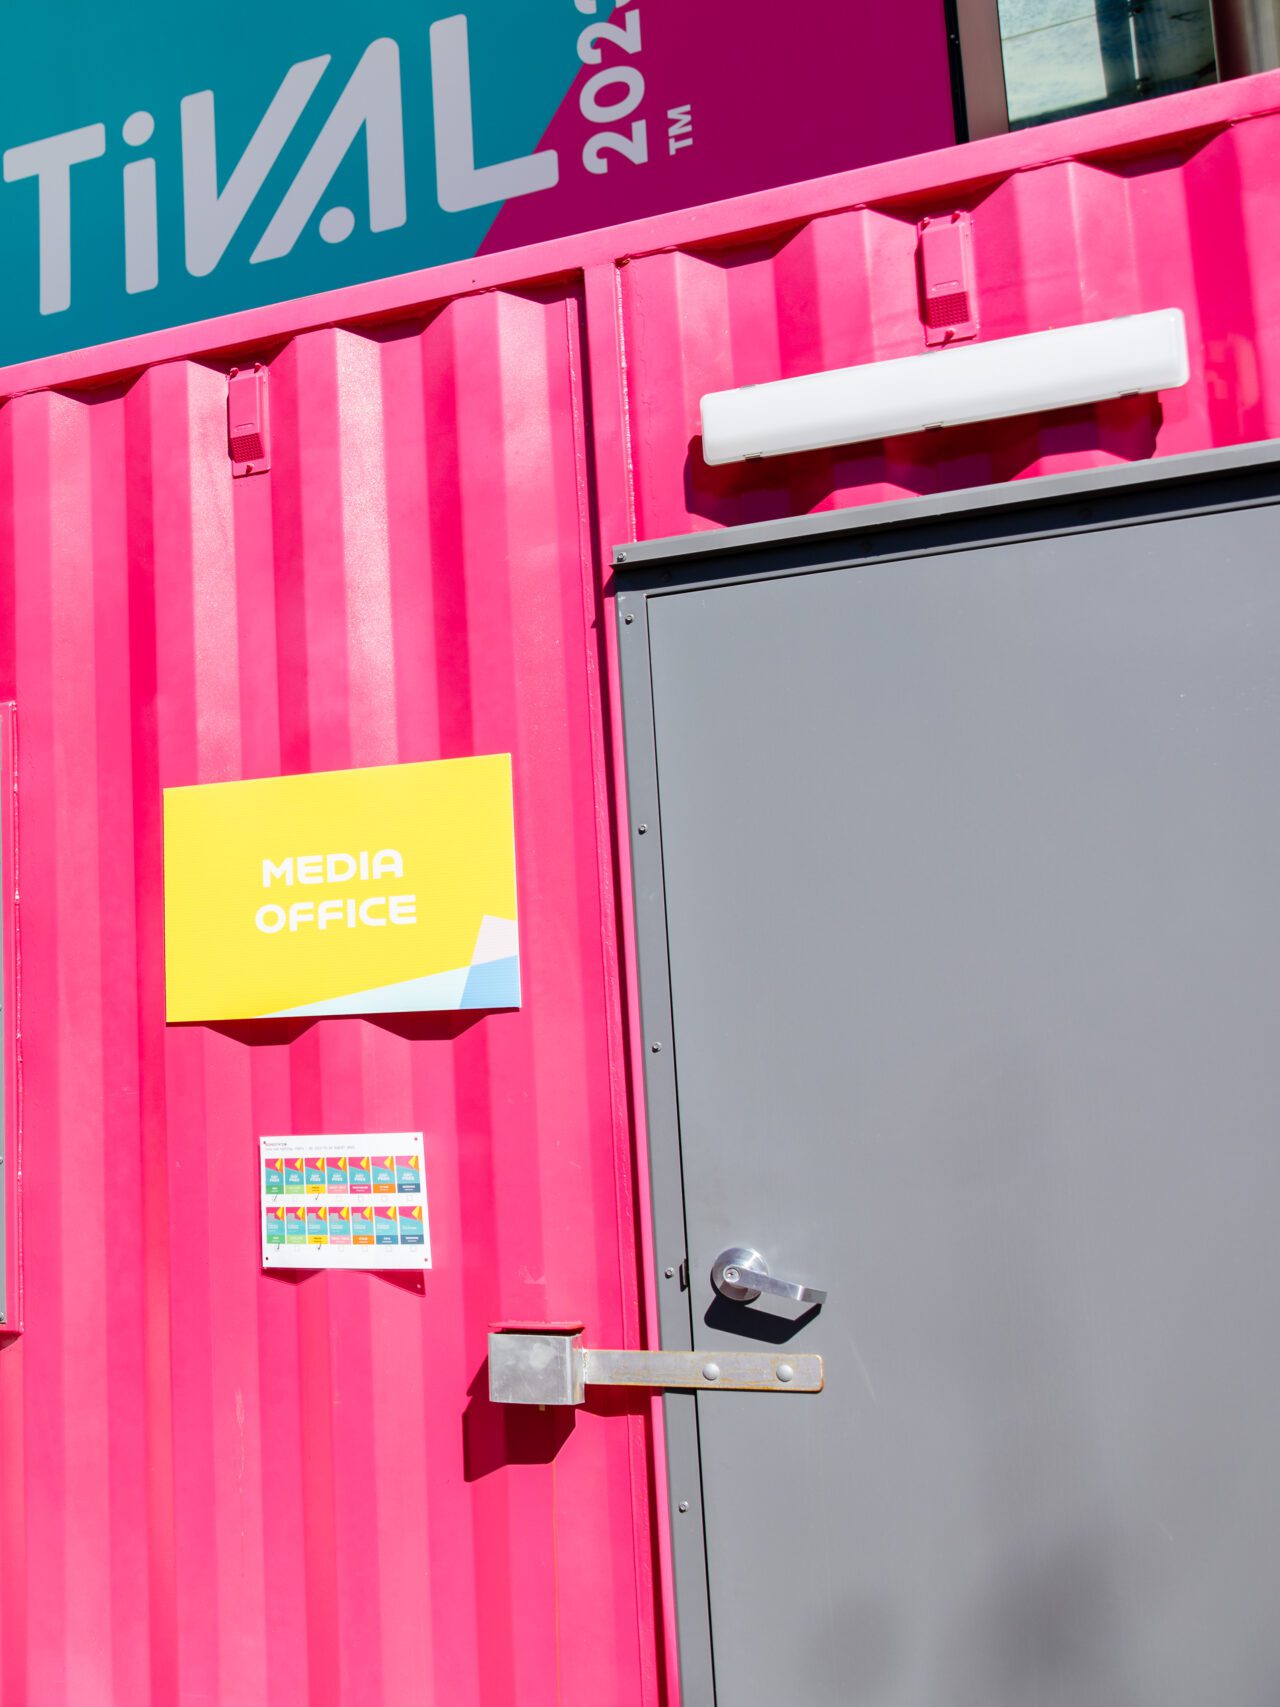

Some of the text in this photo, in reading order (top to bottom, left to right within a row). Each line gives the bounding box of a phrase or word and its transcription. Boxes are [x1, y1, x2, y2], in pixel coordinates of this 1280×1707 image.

[573, 0, 648, 174] 202
[262, 849, 404, 888] MEDIA
[255, 894, 417, 933] OFFICE
